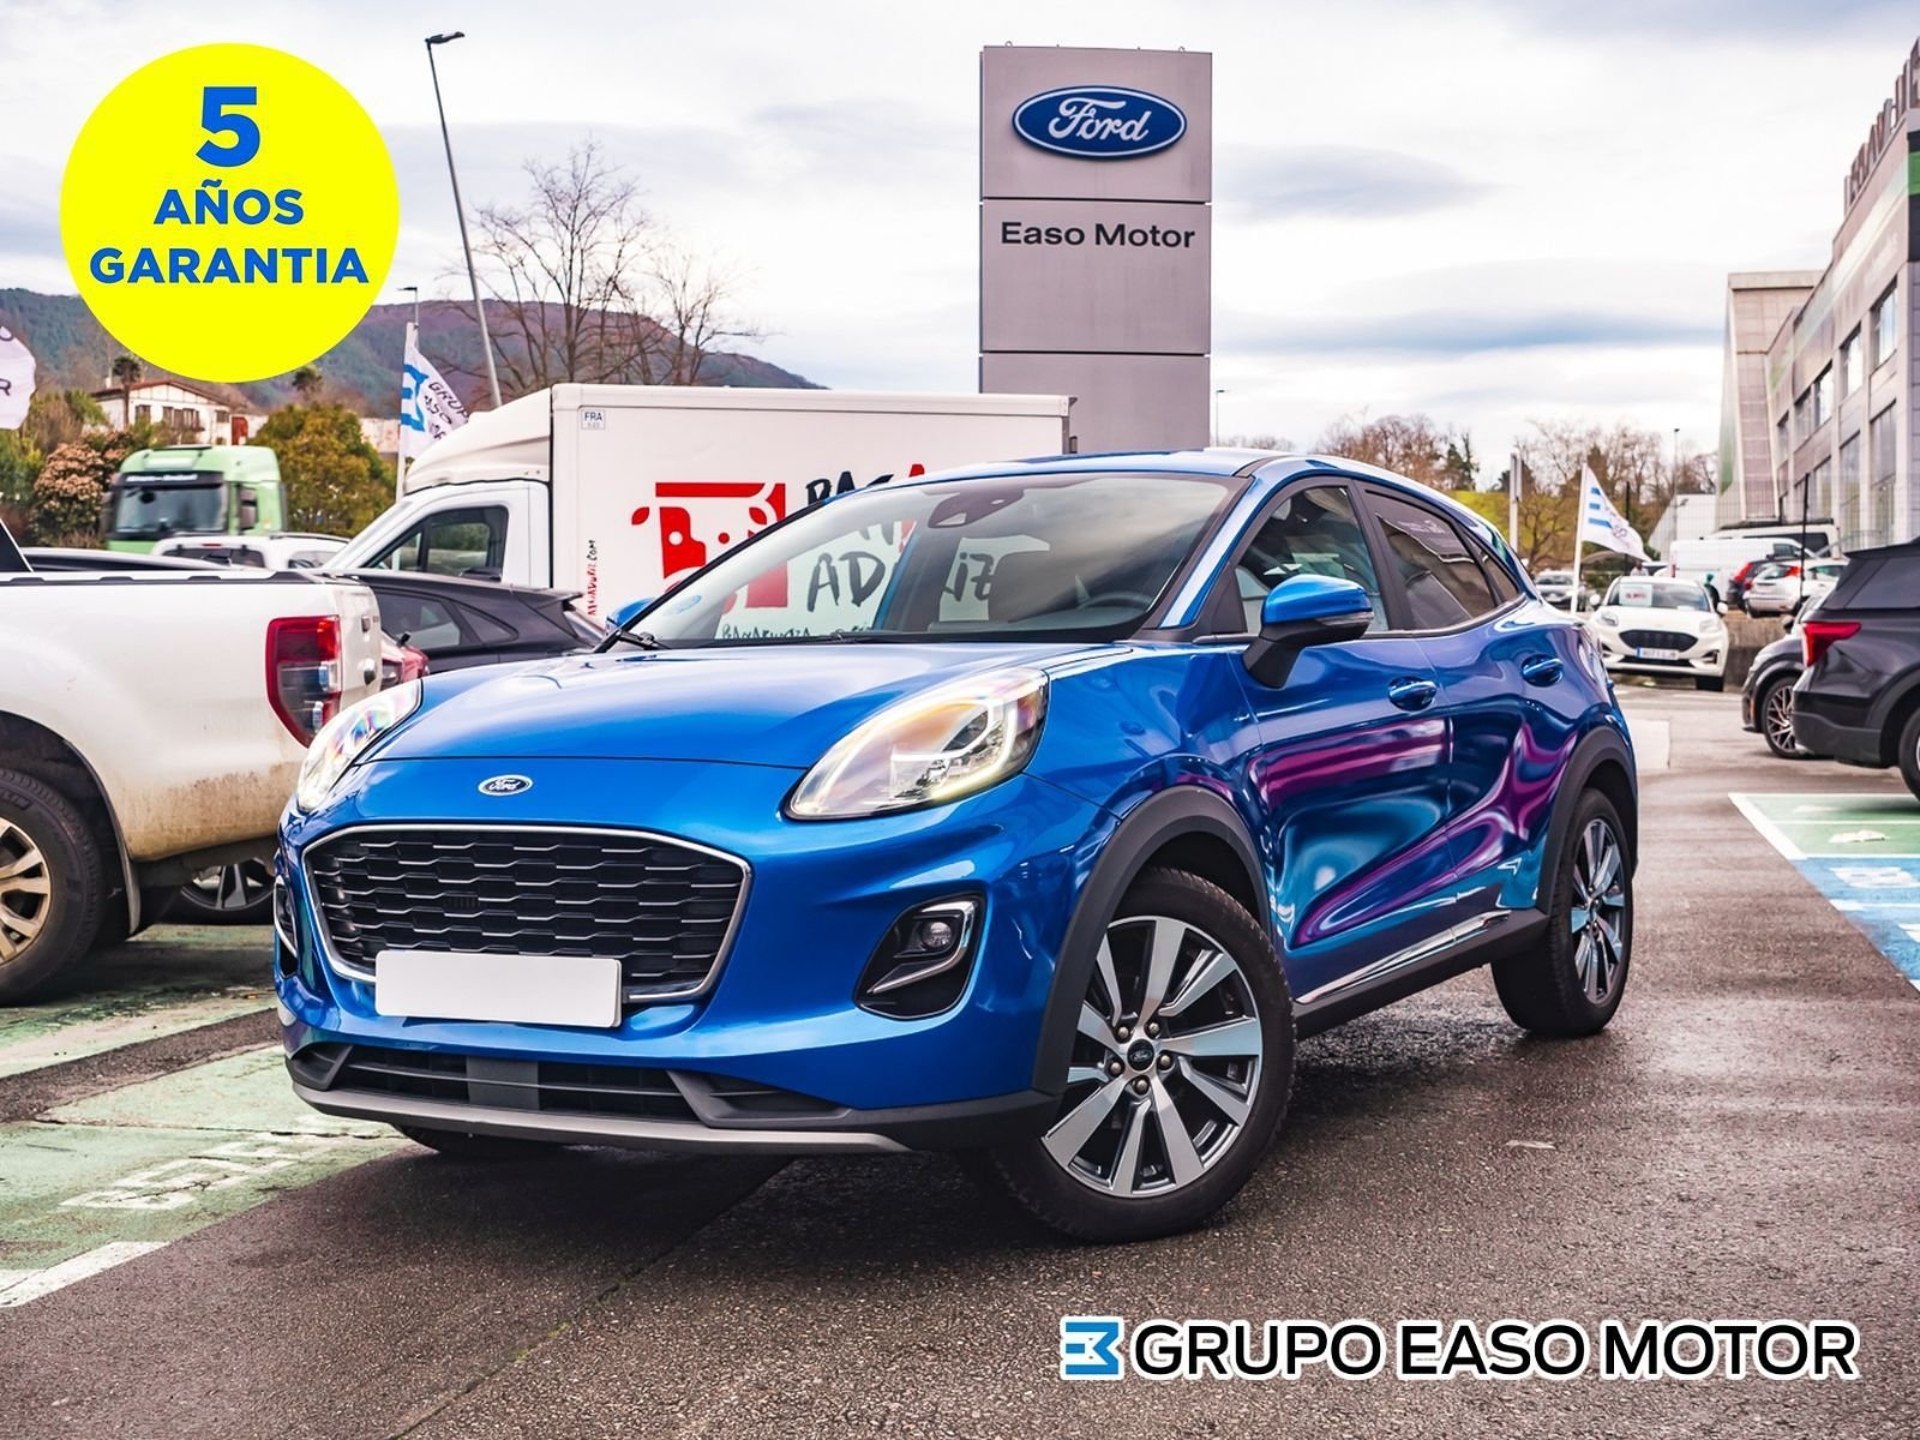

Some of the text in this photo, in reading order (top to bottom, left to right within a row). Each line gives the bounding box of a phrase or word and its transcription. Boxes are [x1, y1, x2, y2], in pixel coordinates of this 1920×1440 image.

[1048, 97, 1152, 142] Ford
[1001, 221, 1196, 248] Easo Motor
